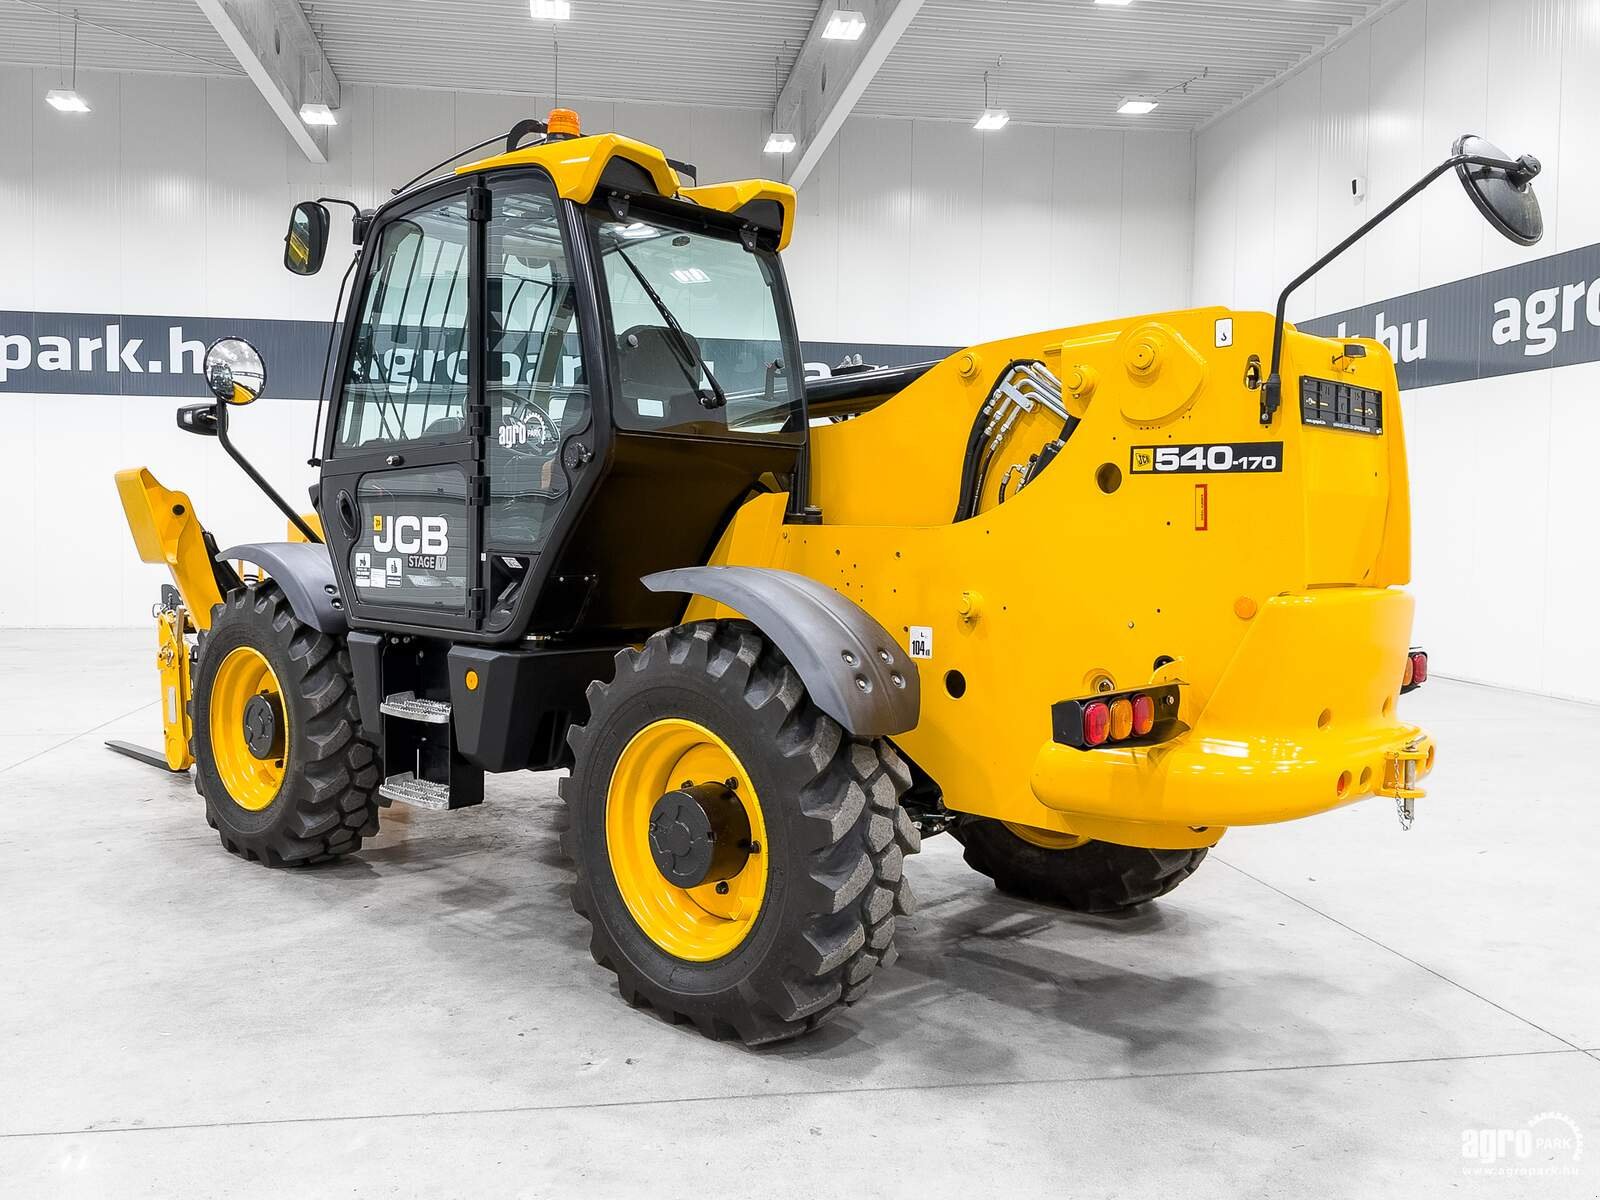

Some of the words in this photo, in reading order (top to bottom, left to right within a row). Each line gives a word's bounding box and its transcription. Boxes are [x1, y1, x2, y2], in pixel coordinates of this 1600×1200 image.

[499, 424, 526, 448] agro
[373, 515, 448, 555] JCB
[408, 555, 435, 569] STAGE
[912, 640, 925, 656] 104
